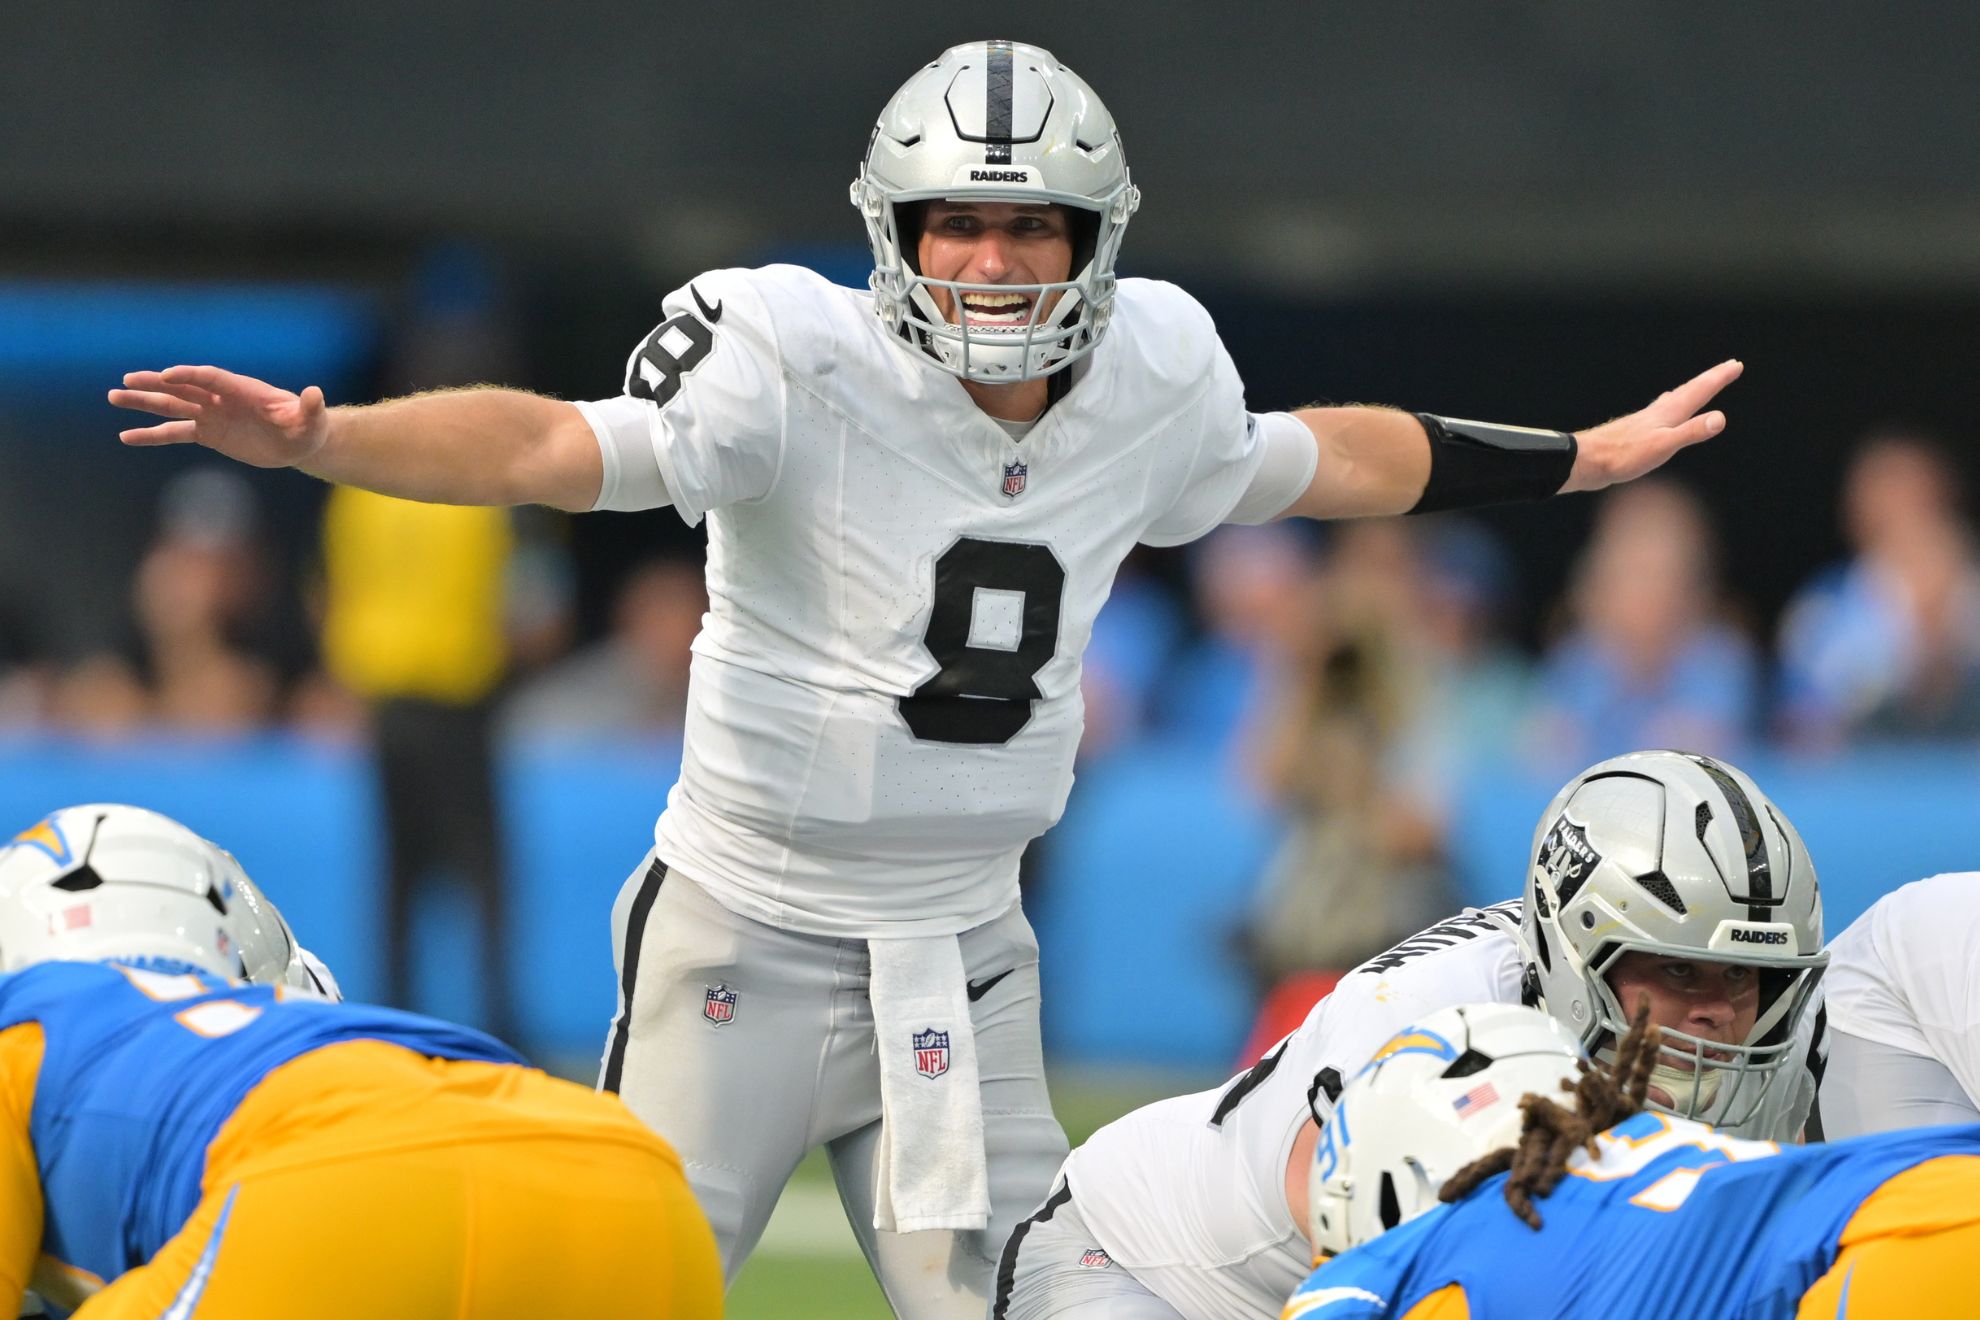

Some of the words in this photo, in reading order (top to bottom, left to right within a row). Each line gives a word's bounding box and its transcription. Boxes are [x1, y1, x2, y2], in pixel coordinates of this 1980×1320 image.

[970, 170, 1028, 183] RAIDERS
[629, 314, 713, 408] 8
[1005, 476, 1024, 492] NFL
[896, 536, 1067, 745] 8
[1557, 820, 1595, 863] RAIDERS
[1730, 928, 1788, 945] RAIDERS
[707, 1001, 732, 1019] NFL
[917, 1049, 946, 1074] NFL
[1083, 1254, 1107, 1266] NFL
